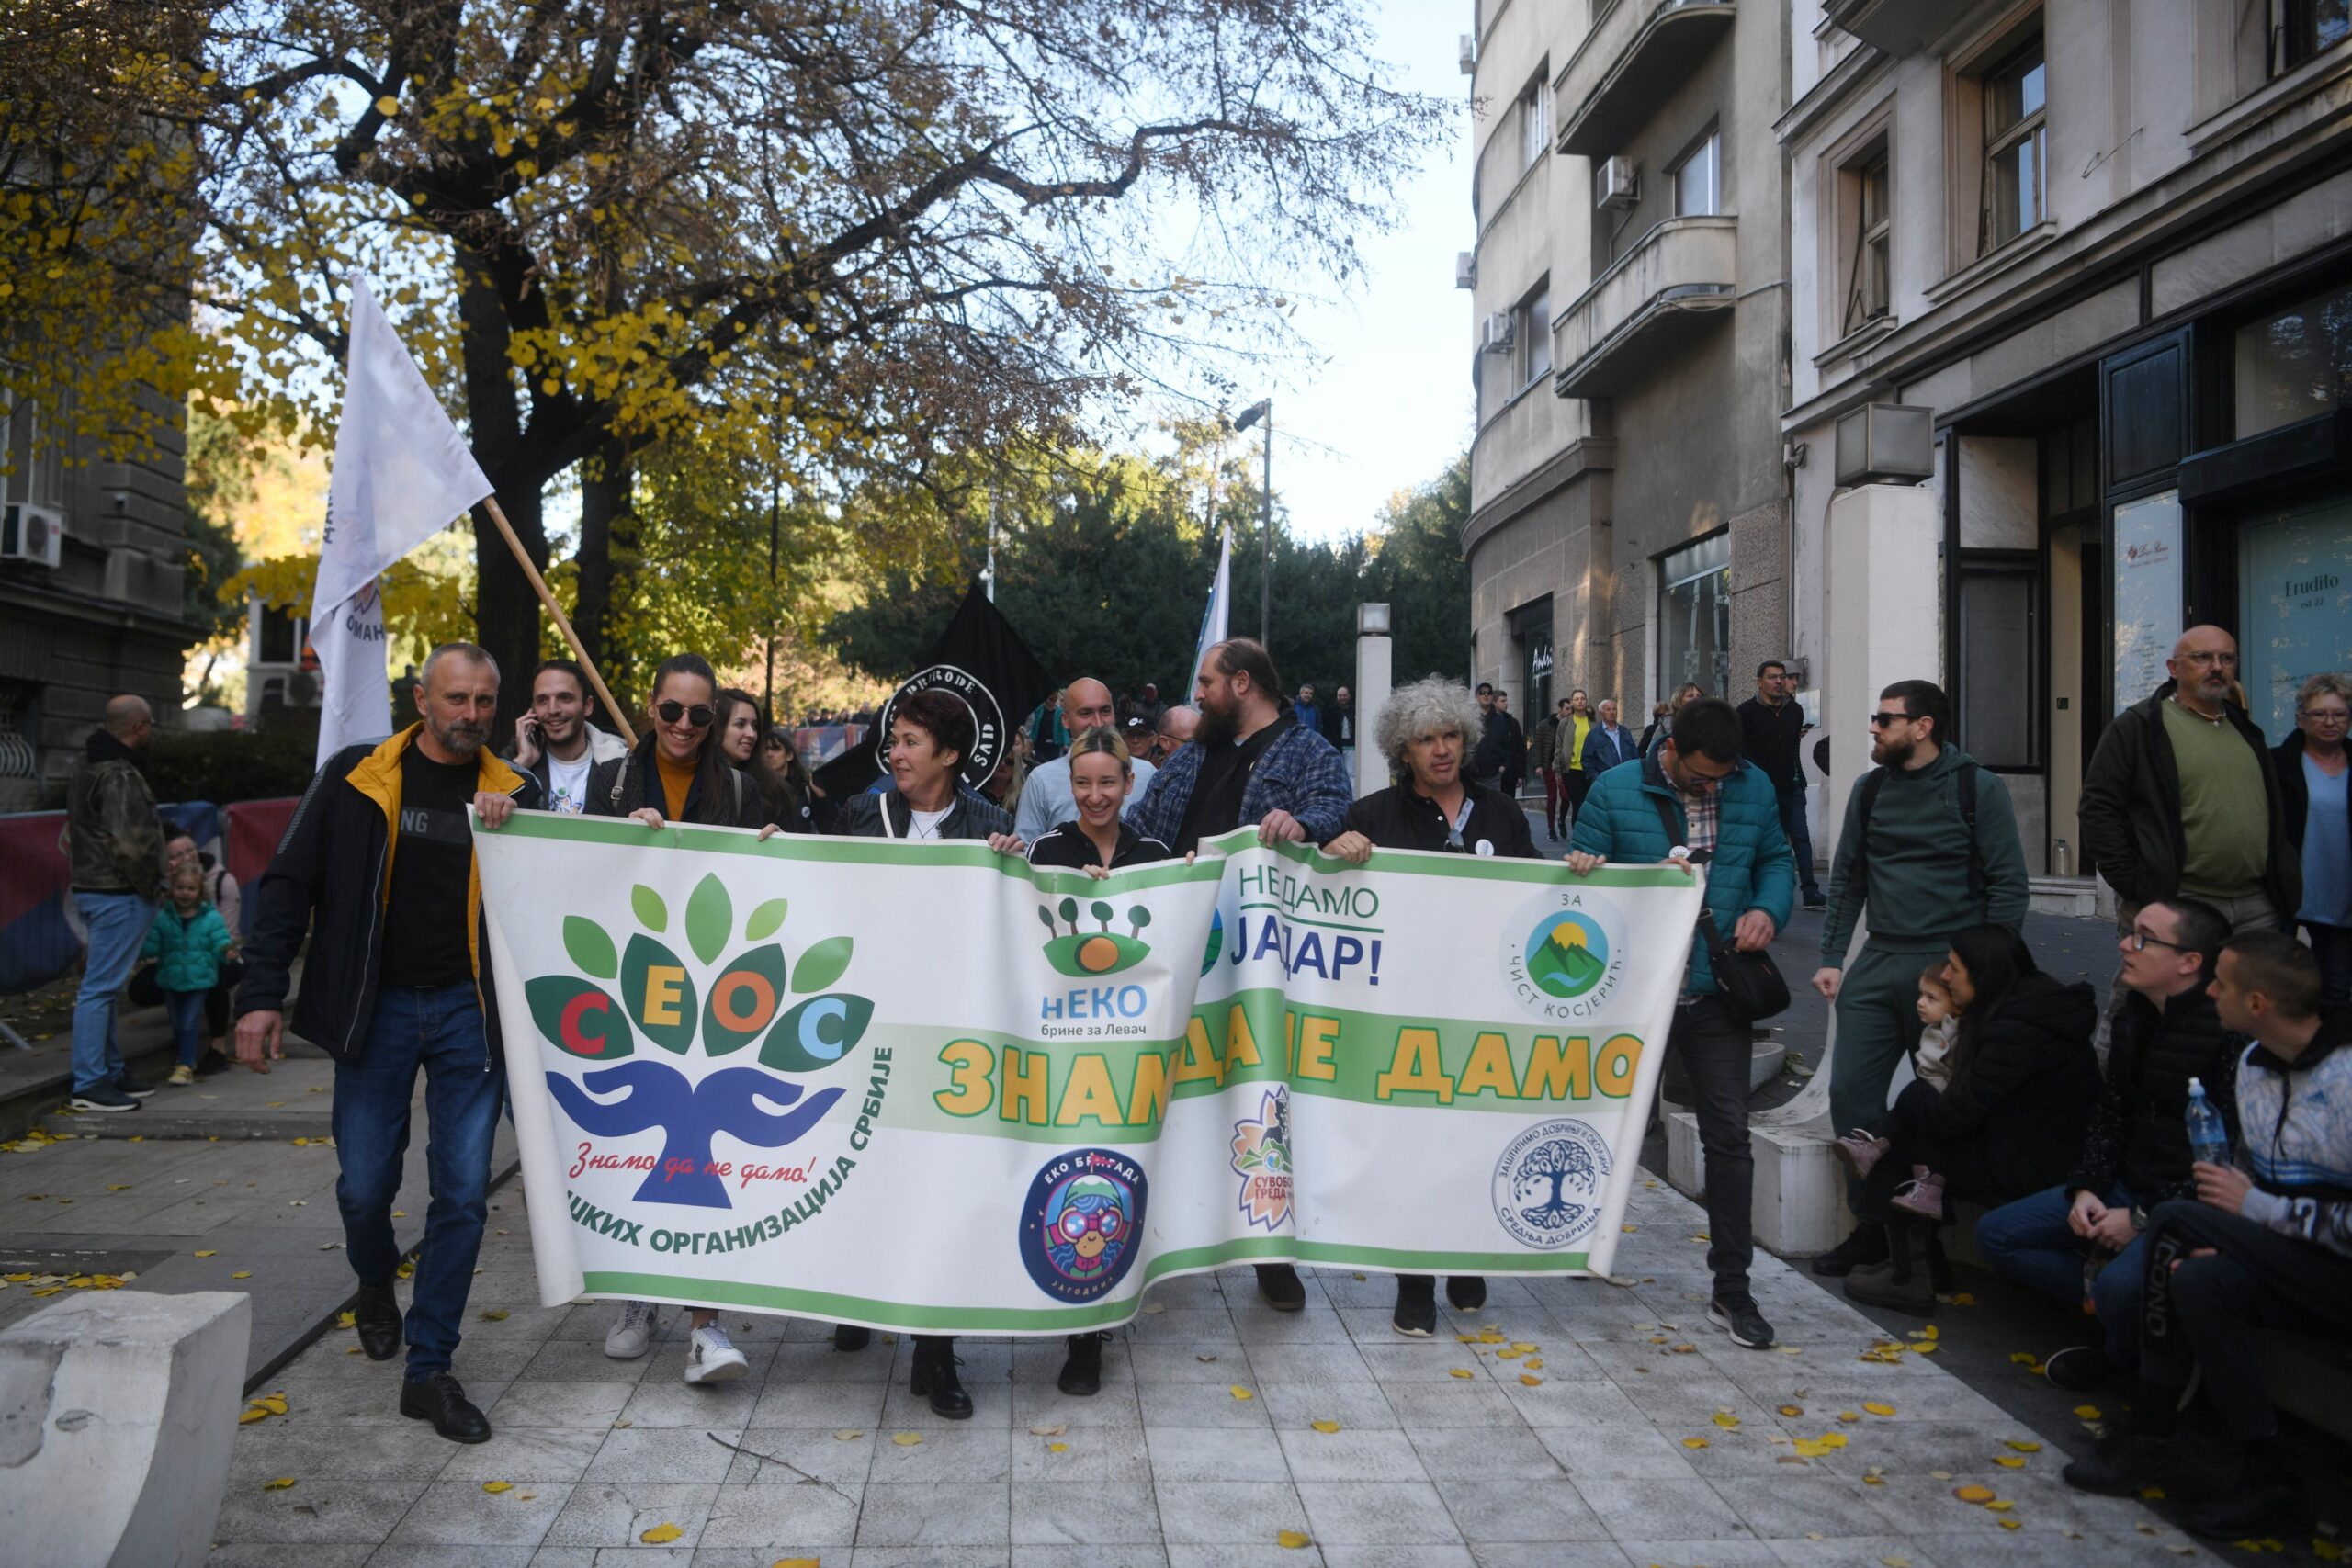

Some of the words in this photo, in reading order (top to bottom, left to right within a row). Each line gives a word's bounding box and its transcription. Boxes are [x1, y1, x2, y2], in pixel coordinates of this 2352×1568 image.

[2285, 574, 2339, 597] Erudito
[1283, 874, 1379, 919] ДАМО
[1561, 893, 1582, 907] ЗА
[1509, 955, 1540, 1005] ЧИСТ
[1544, 960, 1622, 1019] КОСЈЕРИЋ
[1041, 1023, 1083, 1038] брине
[1087, 1025, 1101, 1036] за
[1104, 1023, 1147, 1036] Левач
[1375, 1025, 1645, 1105] ДАМО
[569, 1141, 656, 1179] Знамо
[664, 1157, 695, 1182] да
[704, 1156, 733, 1177] не
[741, 1156, 817, 1189] дамо!
[650, 1156, 856, 1255] ОРГАНИЗАЦИЈА
[850, 1047, 892, 1151] СРБИЈЕ
[1044, 1162, 1069, 1185] ЕКО
[1498, 1130, 1540, 1179] ЗАШТИТИМО
[1501, 1207, 1543, 1244] СРЕДЊА
[1545, 1207, 1602, 1245] ДОБРИЊА
